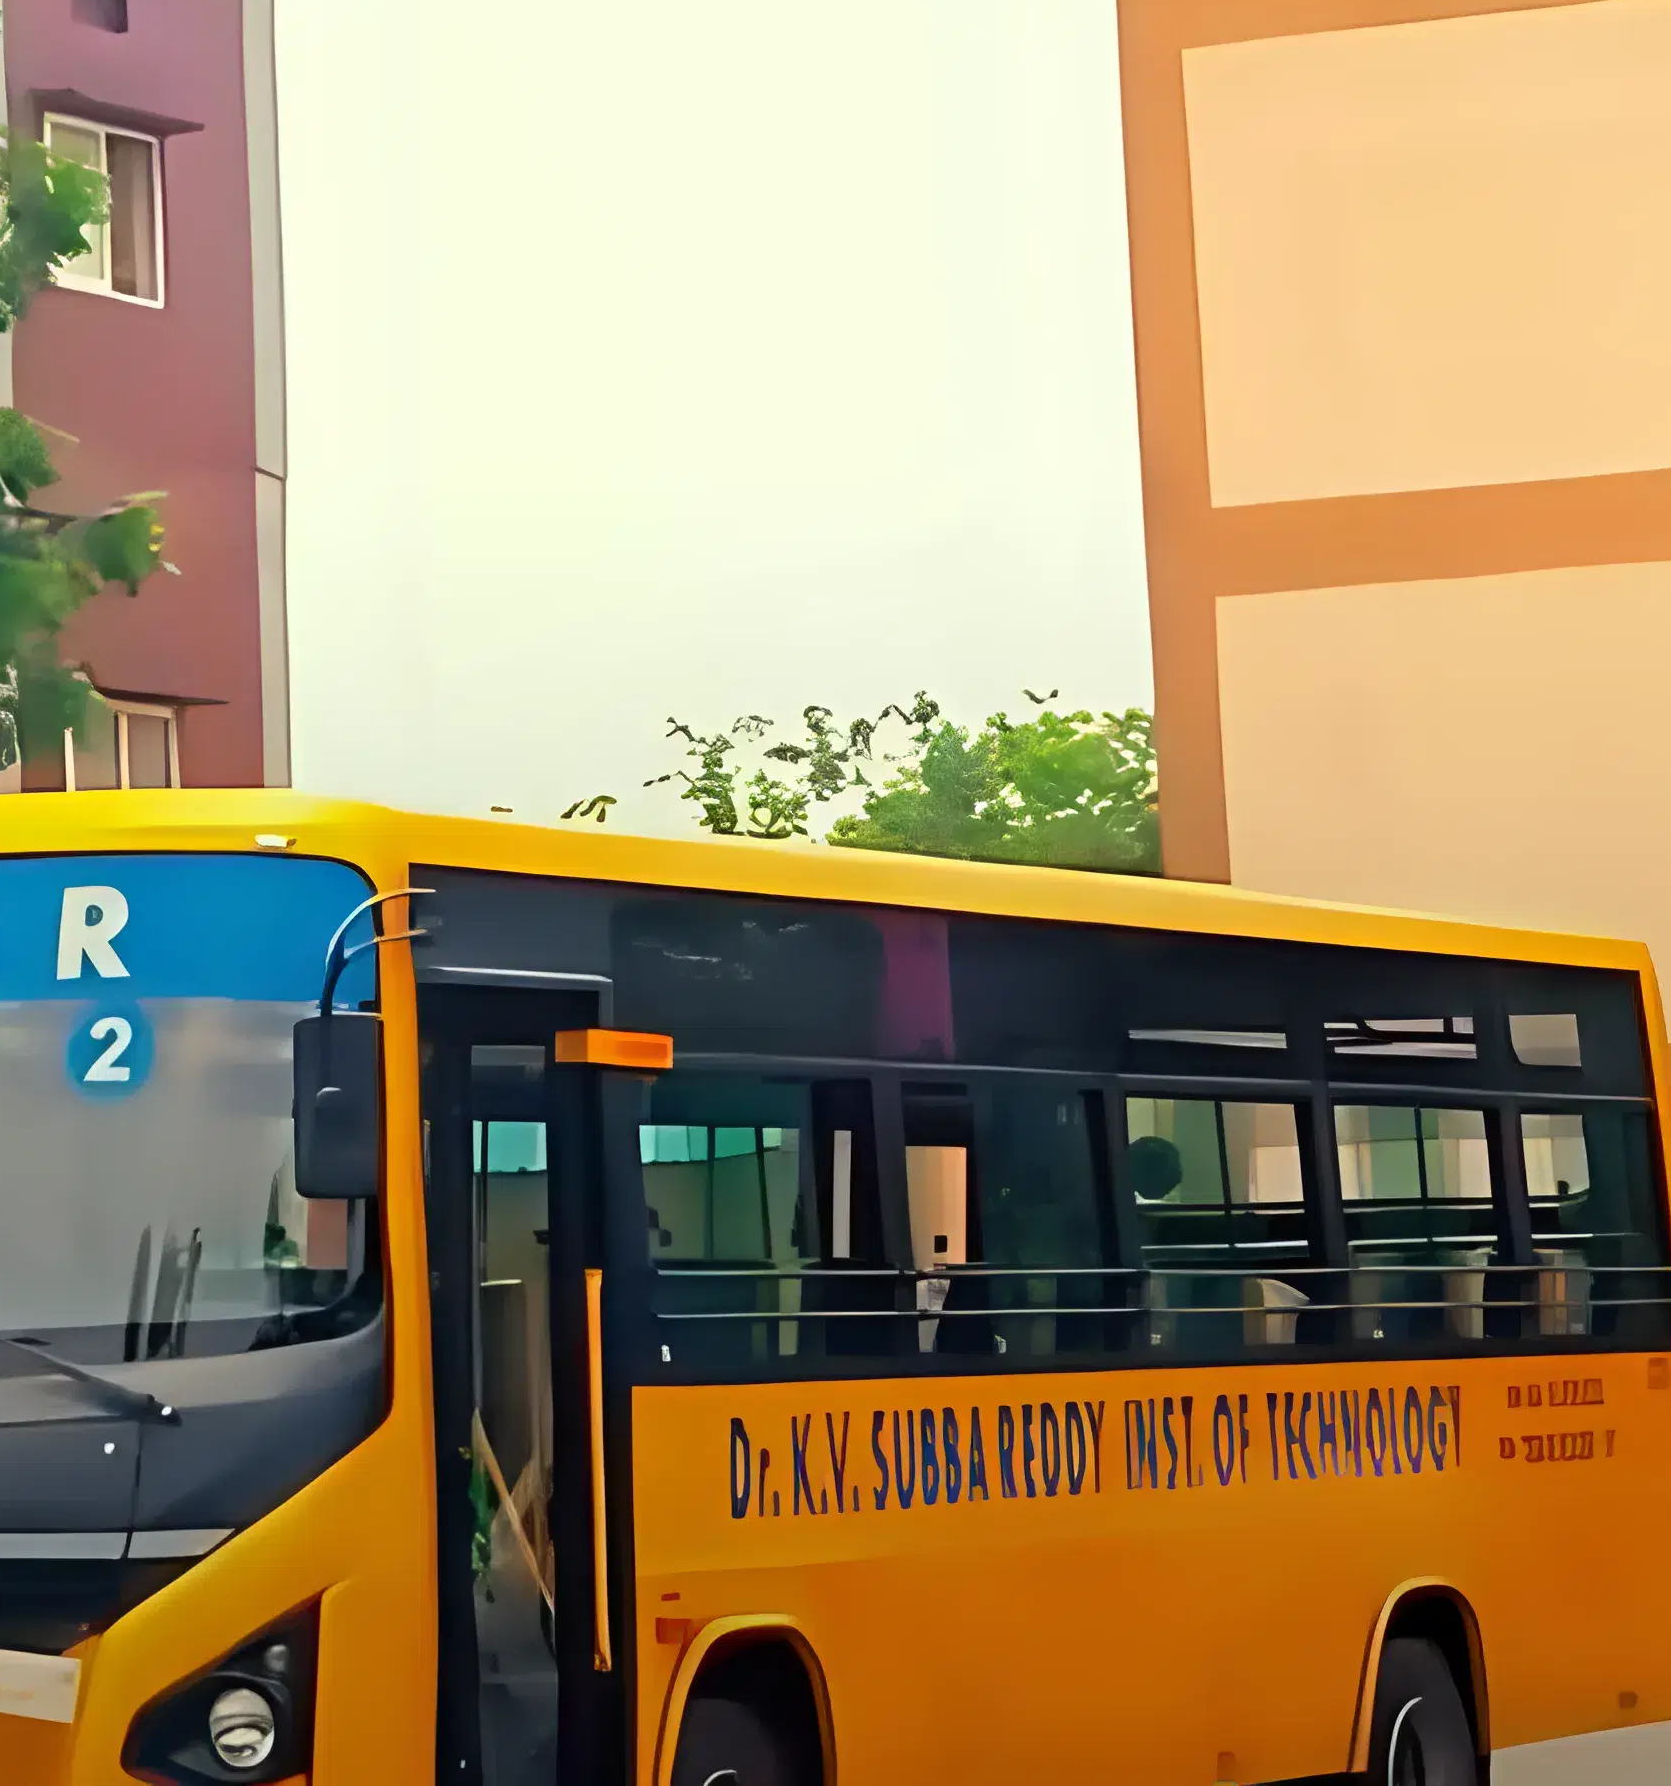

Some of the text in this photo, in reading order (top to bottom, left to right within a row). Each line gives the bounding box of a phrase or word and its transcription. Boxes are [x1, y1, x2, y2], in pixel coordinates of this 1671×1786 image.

[83, 1016, 133, 1082] 2
[730, 1417, 780, 1519] Dr.
[1212, 1393, 1250, 1486] OF
